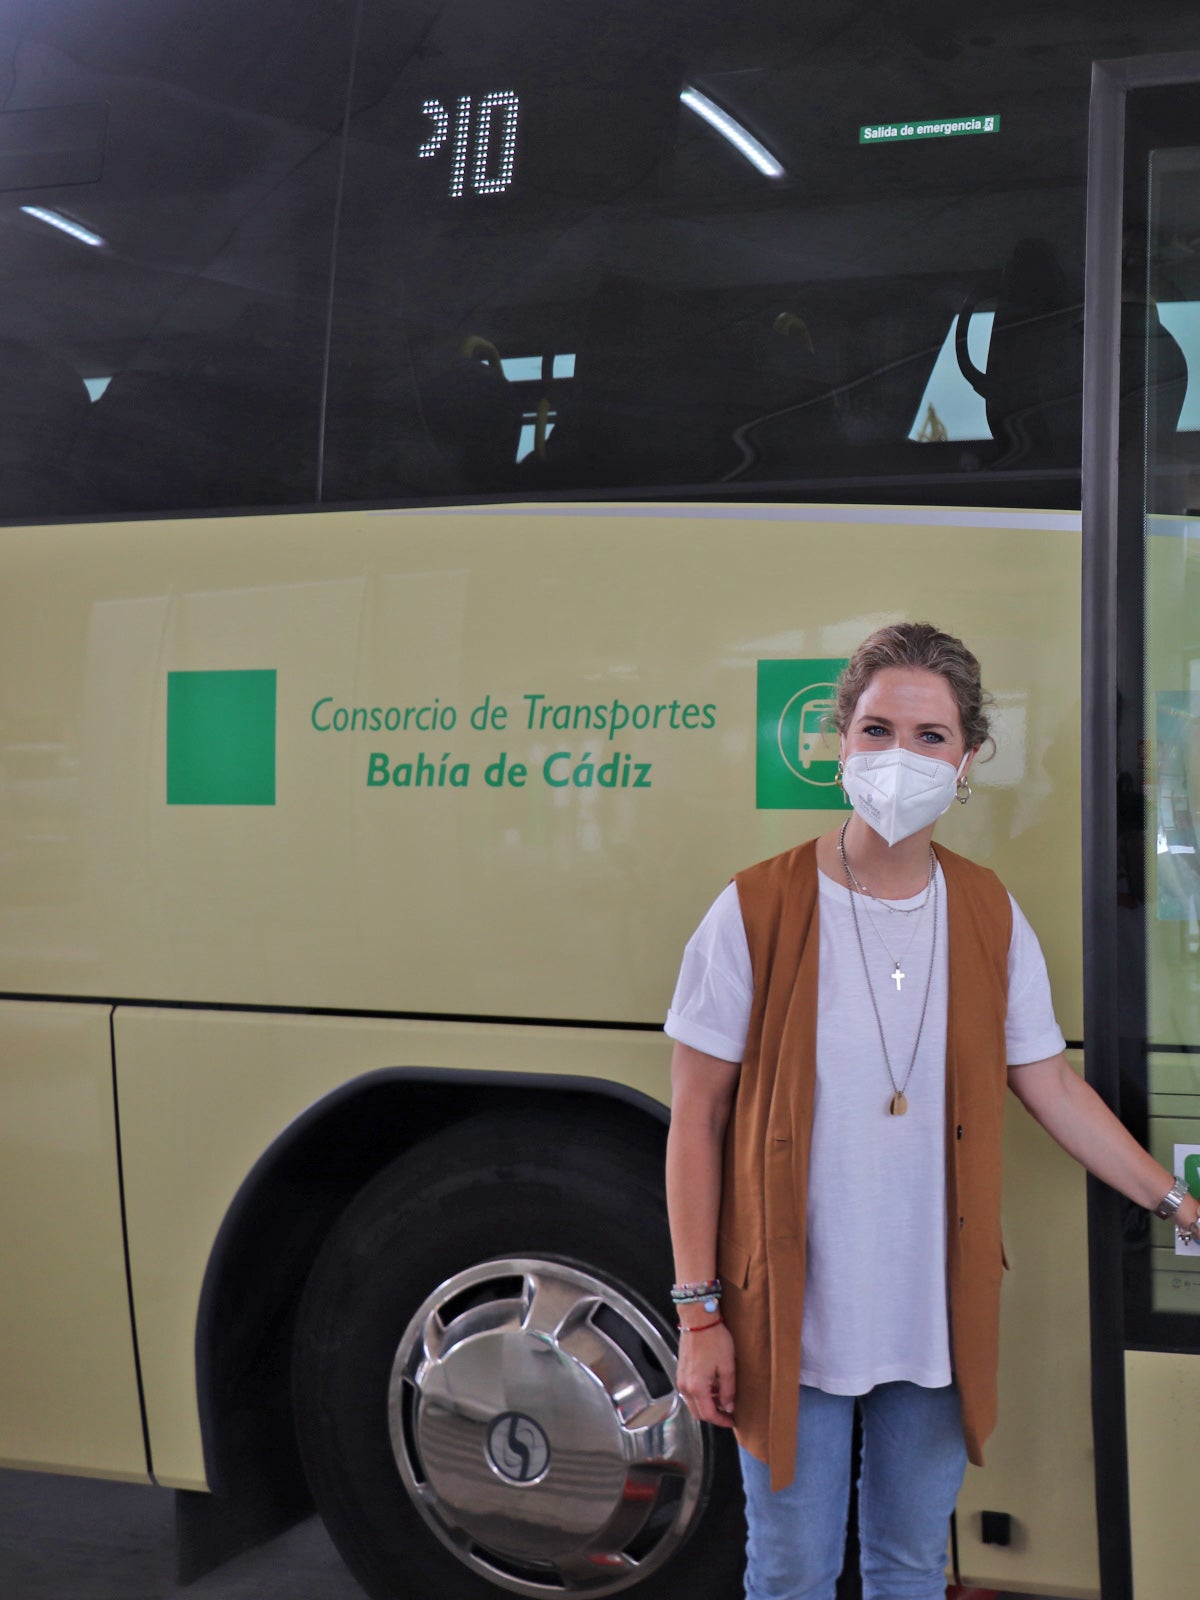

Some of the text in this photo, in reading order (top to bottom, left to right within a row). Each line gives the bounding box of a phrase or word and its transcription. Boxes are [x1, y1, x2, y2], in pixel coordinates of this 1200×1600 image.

[864, 119, 981, 139] Salida de emergencia
[311, 694, 717, 741] Consorcio de Transportes
[366, 752, 653, 788] Bahía de Cádiz
